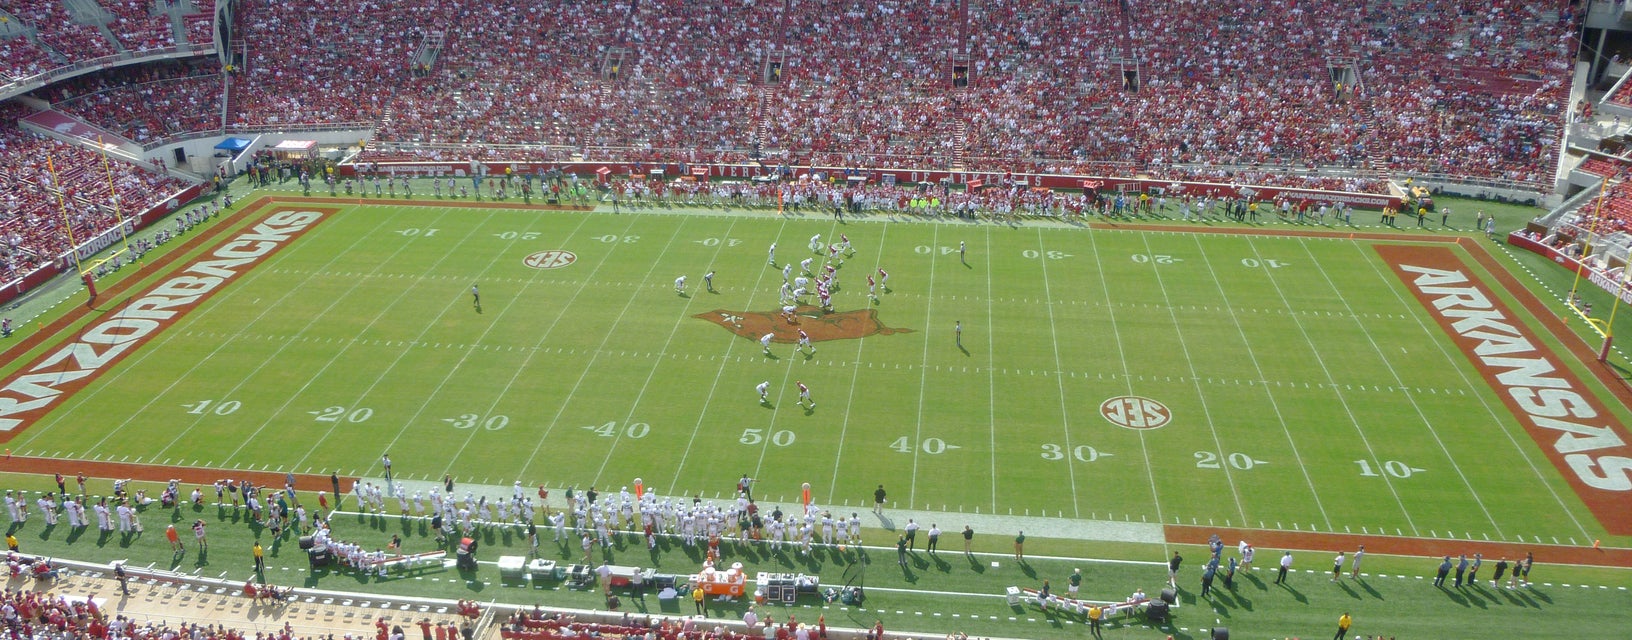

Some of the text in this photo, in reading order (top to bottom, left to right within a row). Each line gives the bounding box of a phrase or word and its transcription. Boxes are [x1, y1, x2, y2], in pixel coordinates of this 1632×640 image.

[683, 166, 798, 178] UIVERSY
[911, 171, 930, 182] OF
[949, 173, 1041, 186] ARKANSAS
[402, 228, 440, 237] 10
[500, 231, 542, 240] 20
[600, 234, 640, 243] 30
[66, 221, 134, 266] RAZORBACKS
[703, 238, 742, 247] 40
[915, 245, 954, 255] 40
[526, 251, 575, 268] SEC
[1022, 250, 1063, 260] 30
[1131, 253, 1173, 264] 20
[1241, 258, 1281, 268] 10
[1588, 272, 1632, 304] ARKANSAS
[1398, 263, 1632, 491] ARKANSAS
[187, 400, 242, 416] 10
[315, 406, 373, 423] 20
[1105, 398, 1167, 427] SEC
[453, 413, 509, 430] 30
[594, 421, 650, 438] 40
[739, 428, 796, 446] 50
[889, 436, 945, 454] 40
[1040, 443, 1098, 462] 30
[1193, 451, 1253, 470] 20
[1353, 459, 1411, 478] 10
[704, 583, 713, 592] G
[730, 585, 739, 594] G
